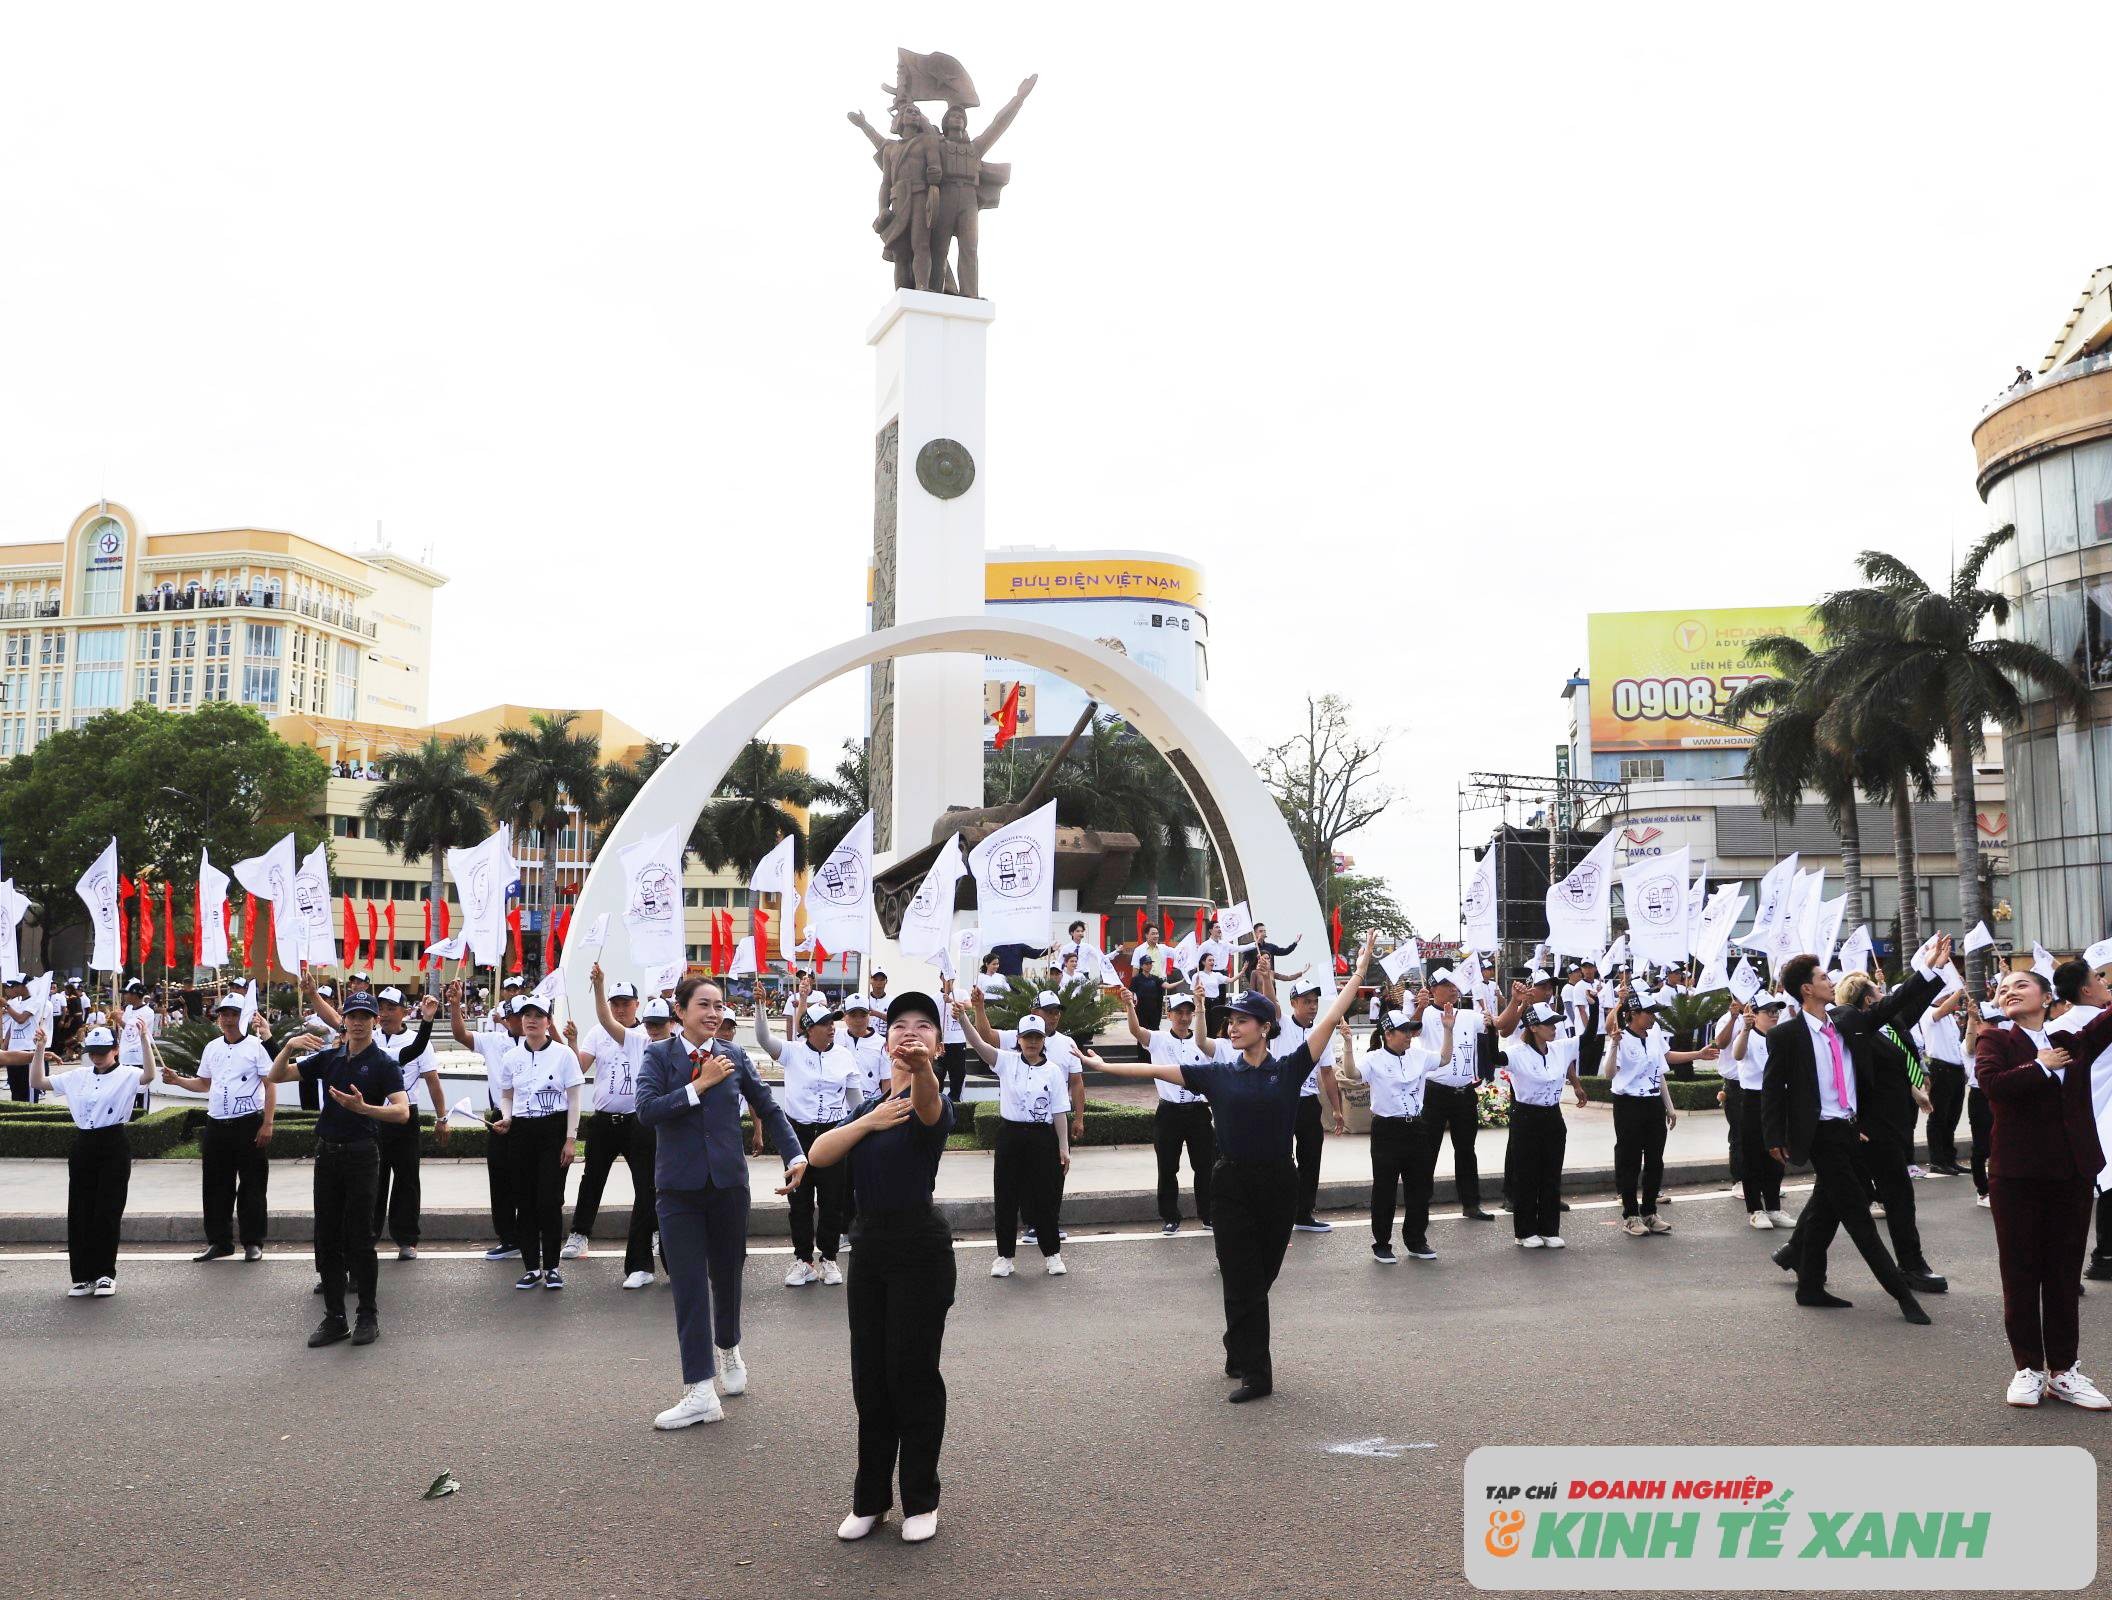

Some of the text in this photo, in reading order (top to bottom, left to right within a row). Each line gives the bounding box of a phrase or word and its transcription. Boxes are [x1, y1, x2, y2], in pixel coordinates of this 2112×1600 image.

[1104, 571, 1143, 588] VIỆT
[1146, 576, 1180, 589] NAM
[1977, 839, 2008, 848] AVAC
[1420, 950, 1445, 958] 2025
